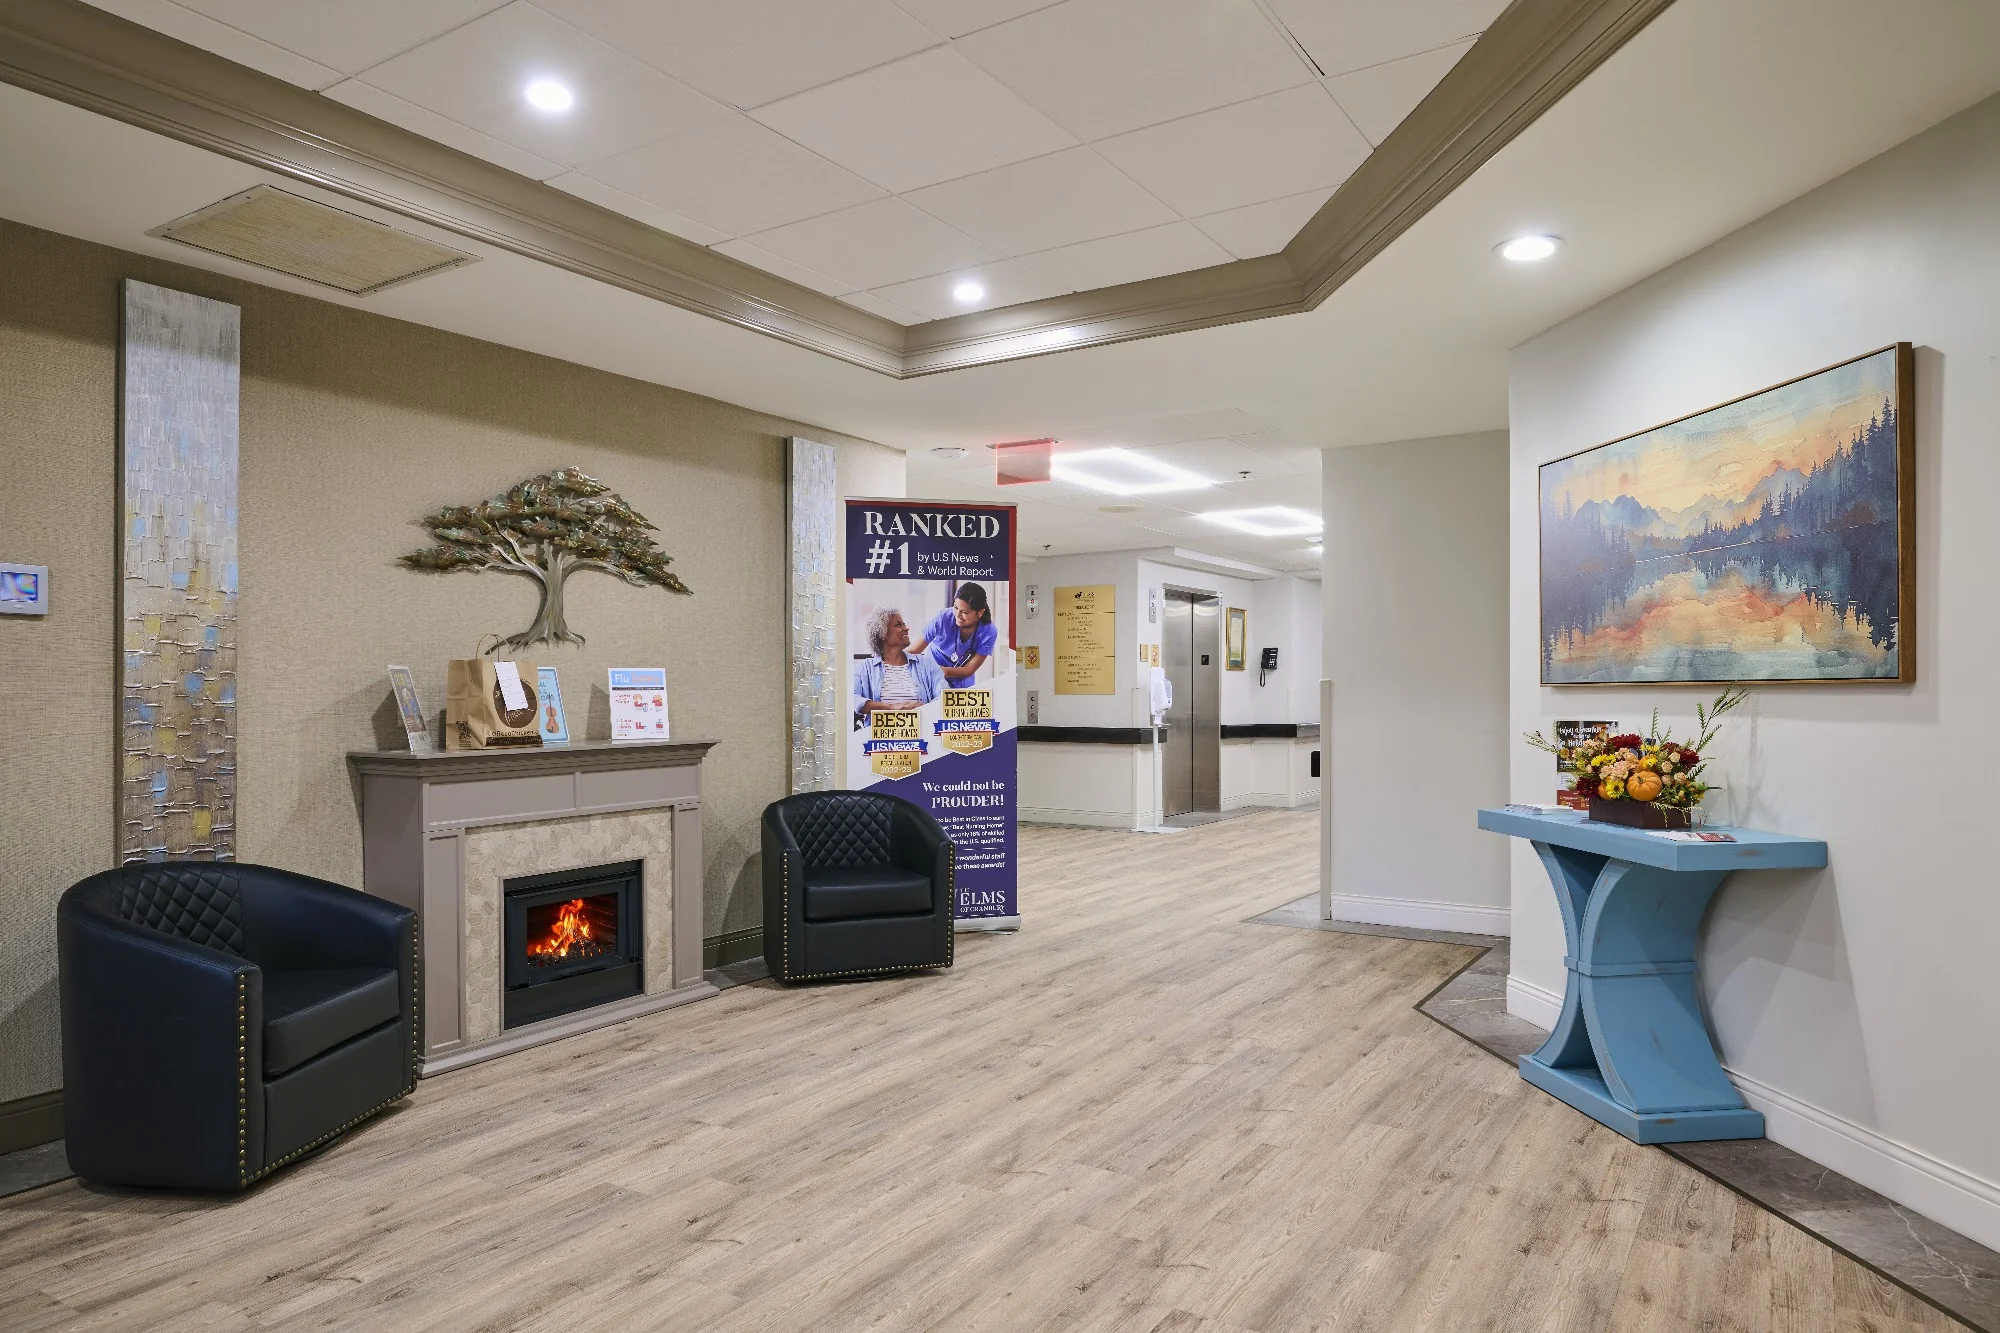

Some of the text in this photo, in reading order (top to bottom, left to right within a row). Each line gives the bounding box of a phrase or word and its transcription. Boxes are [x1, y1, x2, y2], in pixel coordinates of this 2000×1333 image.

[863, 511, 1000, 539] RANKED
[865, 539, 911, 575] #1
[917, 552, 979, 563] by U.S News
[917, 566, 994, 577] & World Report
[614, 672, 660, 685] Flu Safety
[944, 691, 990, 707] BEST
[970, 707, 990, 717] HOMES
[873, 712, 918, 728] BEST
[951, 740, 983, 748] 2022-23
[880, 766, 912, 774] 2022-23
[922, 779, 1005, 792] We could not be
[931, 794, 1004, 809] PROUDER!
[959, 853, 991, 861] wonderful
[991, 852, 1006, 860] staff
[960, 890, 1006, 906] ELMS
